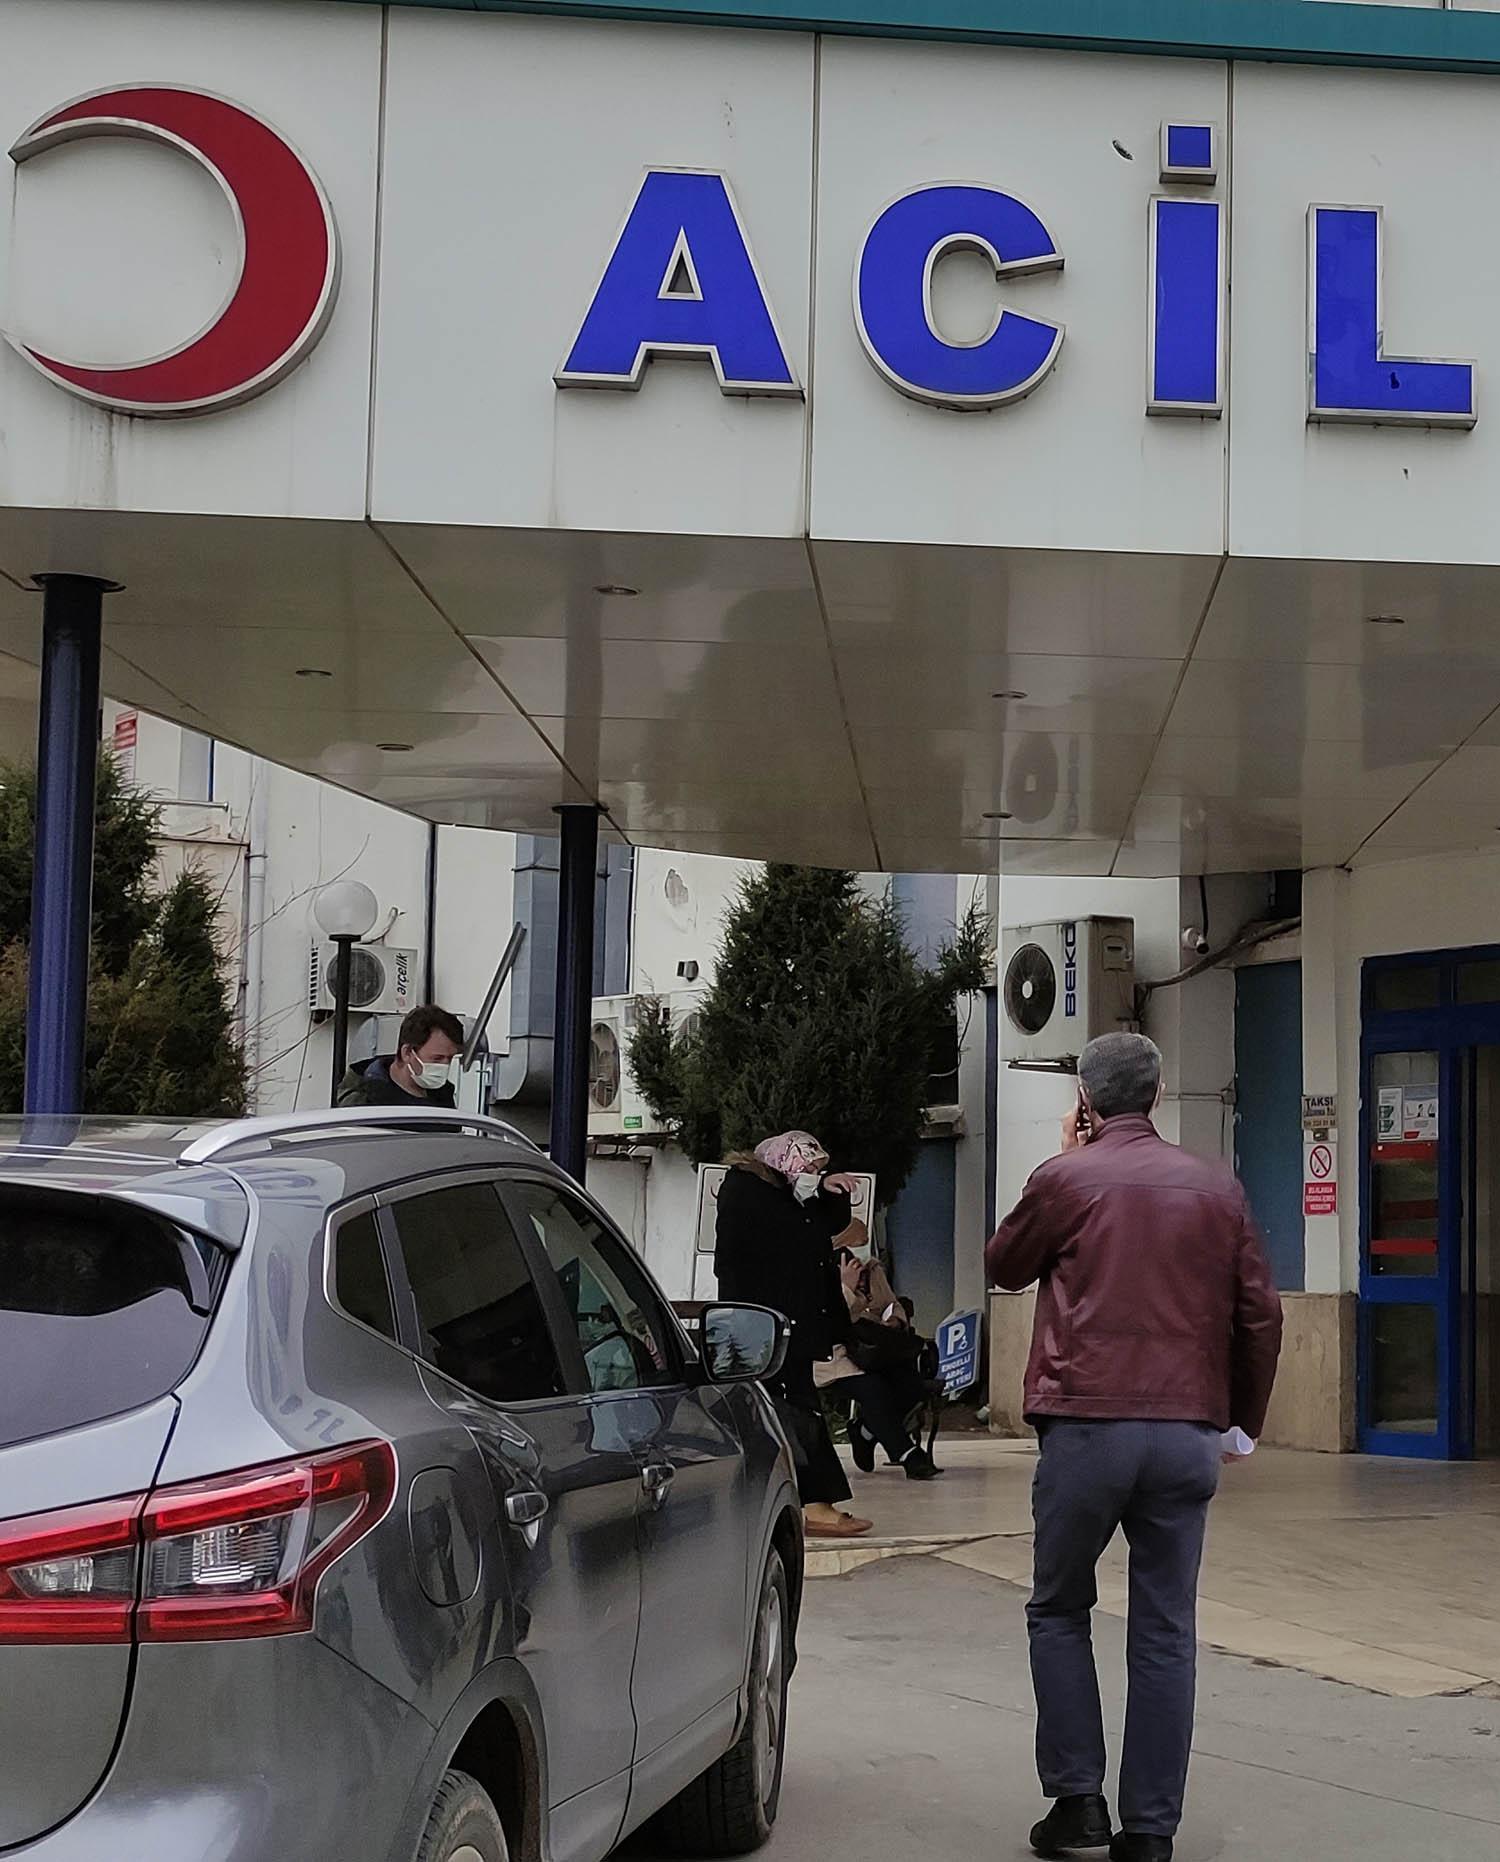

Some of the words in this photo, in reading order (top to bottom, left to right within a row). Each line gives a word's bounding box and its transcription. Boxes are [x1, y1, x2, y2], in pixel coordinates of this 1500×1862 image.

[554, 121, 1479, 430] ACİL
[396, 952, 410, 996] arçelik
[1065, 922, 1076, 1016] BEKO
[947, 1323, 966, 1355] P
